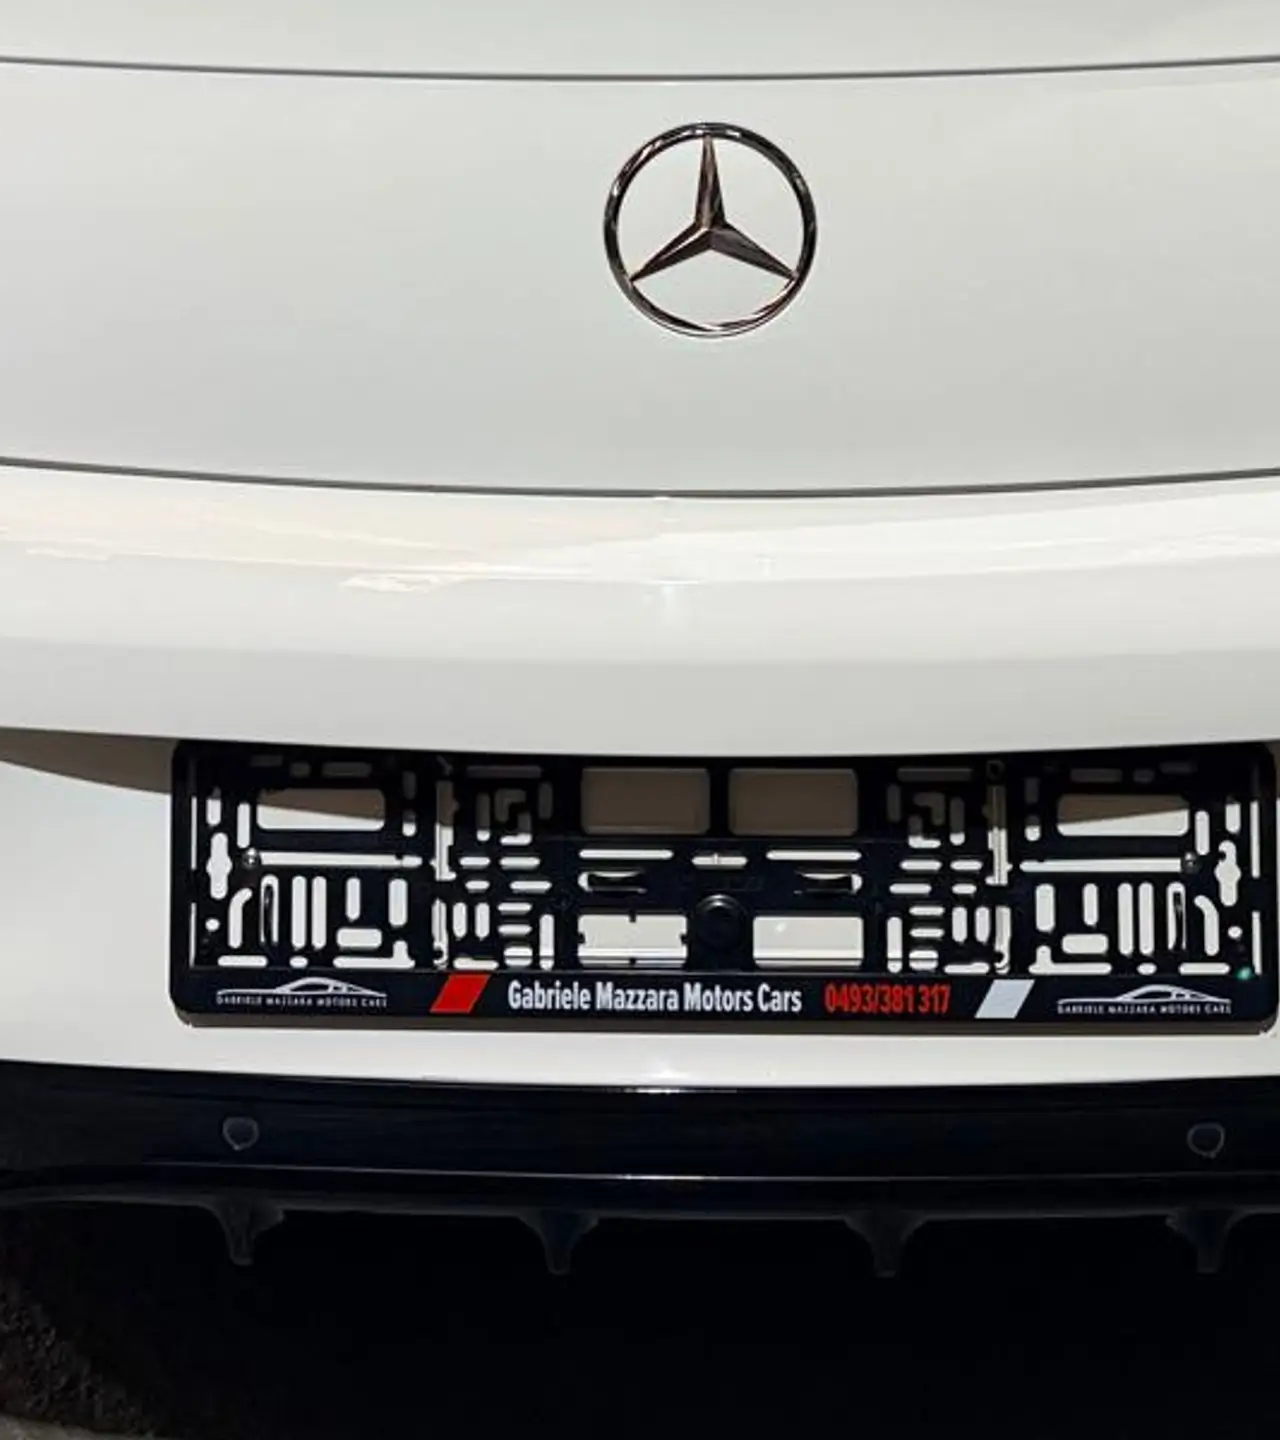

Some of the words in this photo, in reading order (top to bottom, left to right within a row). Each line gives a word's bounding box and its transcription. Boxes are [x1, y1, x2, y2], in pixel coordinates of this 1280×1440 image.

[508, 980, 592, 1010] Gabriele
[596, 982, 678, 1011] Mazzara
[683, 982, 754, 1012] Motors
[757, 983, 802, 1013] Cars
[824, 984, 915, 1014] 0493/381
[917, 984, 951, 1013] 317
